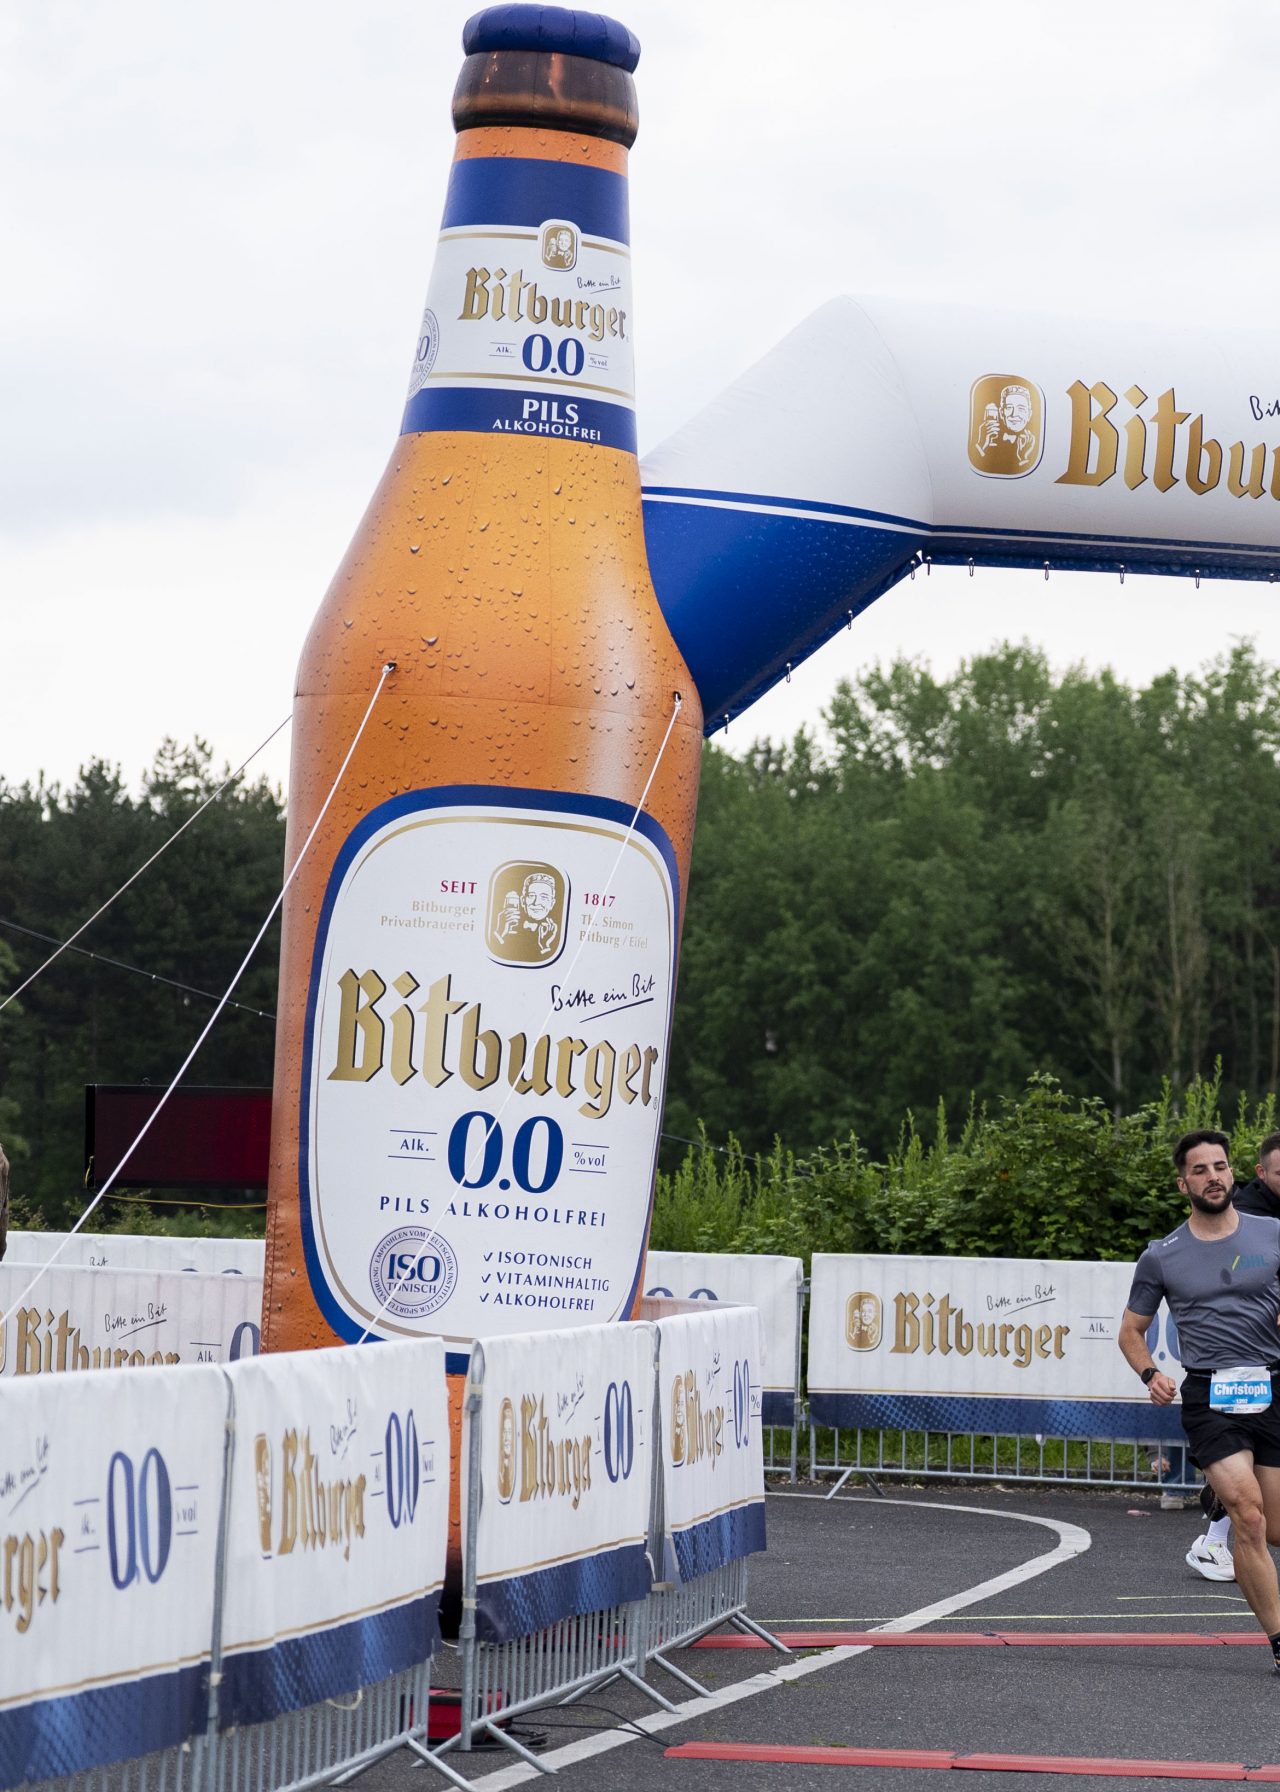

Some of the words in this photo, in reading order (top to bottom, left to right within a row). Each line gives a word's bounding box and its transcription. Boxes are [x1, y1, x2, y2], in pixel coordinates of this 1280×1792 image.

[457, 267, 627, 342] Bitburger
[522, 333, 585, 376] 0.0
[522, 398, 580, 424] PILS
[492, 418, 601, 441] ALKOHOLFREI
[440, 880, 478, 895] SEIT
[411, 899, 477, 916] Bitburger
[583, 892, 616, 908] 1817
[380, 914, 475, 932] Privatbrauerei
[602, 916, 634, 931] Simon
[579, 930, 621, 949] Bitburg
[551, 984, 595, 1011] Bitte
[603, 991, 627, 1003] ein
[632, 973, 656, 998] Bit
[327, 968, 659, 1119] Bitburger
[400, 1138, 430, 1153] Alk.
[447, 1110, 564, 1194] 0.0
[380, 1196, 430, 1214] PILS
[444, 1201, 606, 1227] ALKOHOLFREI
[375, 1231, 408, 1264] EMPFOHLEN
[409, 1230, 426, 1238] VOM
[387, 1253, 441, 1283] ISO
[498, 1251, 593, 1270] ISOTONISCH
[387, 1281, 437, 1295] TONISCH
[496, 1272, 610, 1293] VITAMINHALTIG
[493, 1292, 594, 1311] ALKOHOLFREI
[986, 1295, 1012, 1310] Bitte
[1035, 1284, 1056, 1299] Bit
[105, 1313, 127, 1332] Bitte
[131, 1315, 145, 1326] ein
[148, 1303, 167, 1320] Bit
[1089, 1323, 1109, 1333] Alk.
[889, 1292, 1070, 1368] Bitburger
[197, 1351, 216, 1363] Alk.
[1214, 1383, 1268, 1397] Christoph
